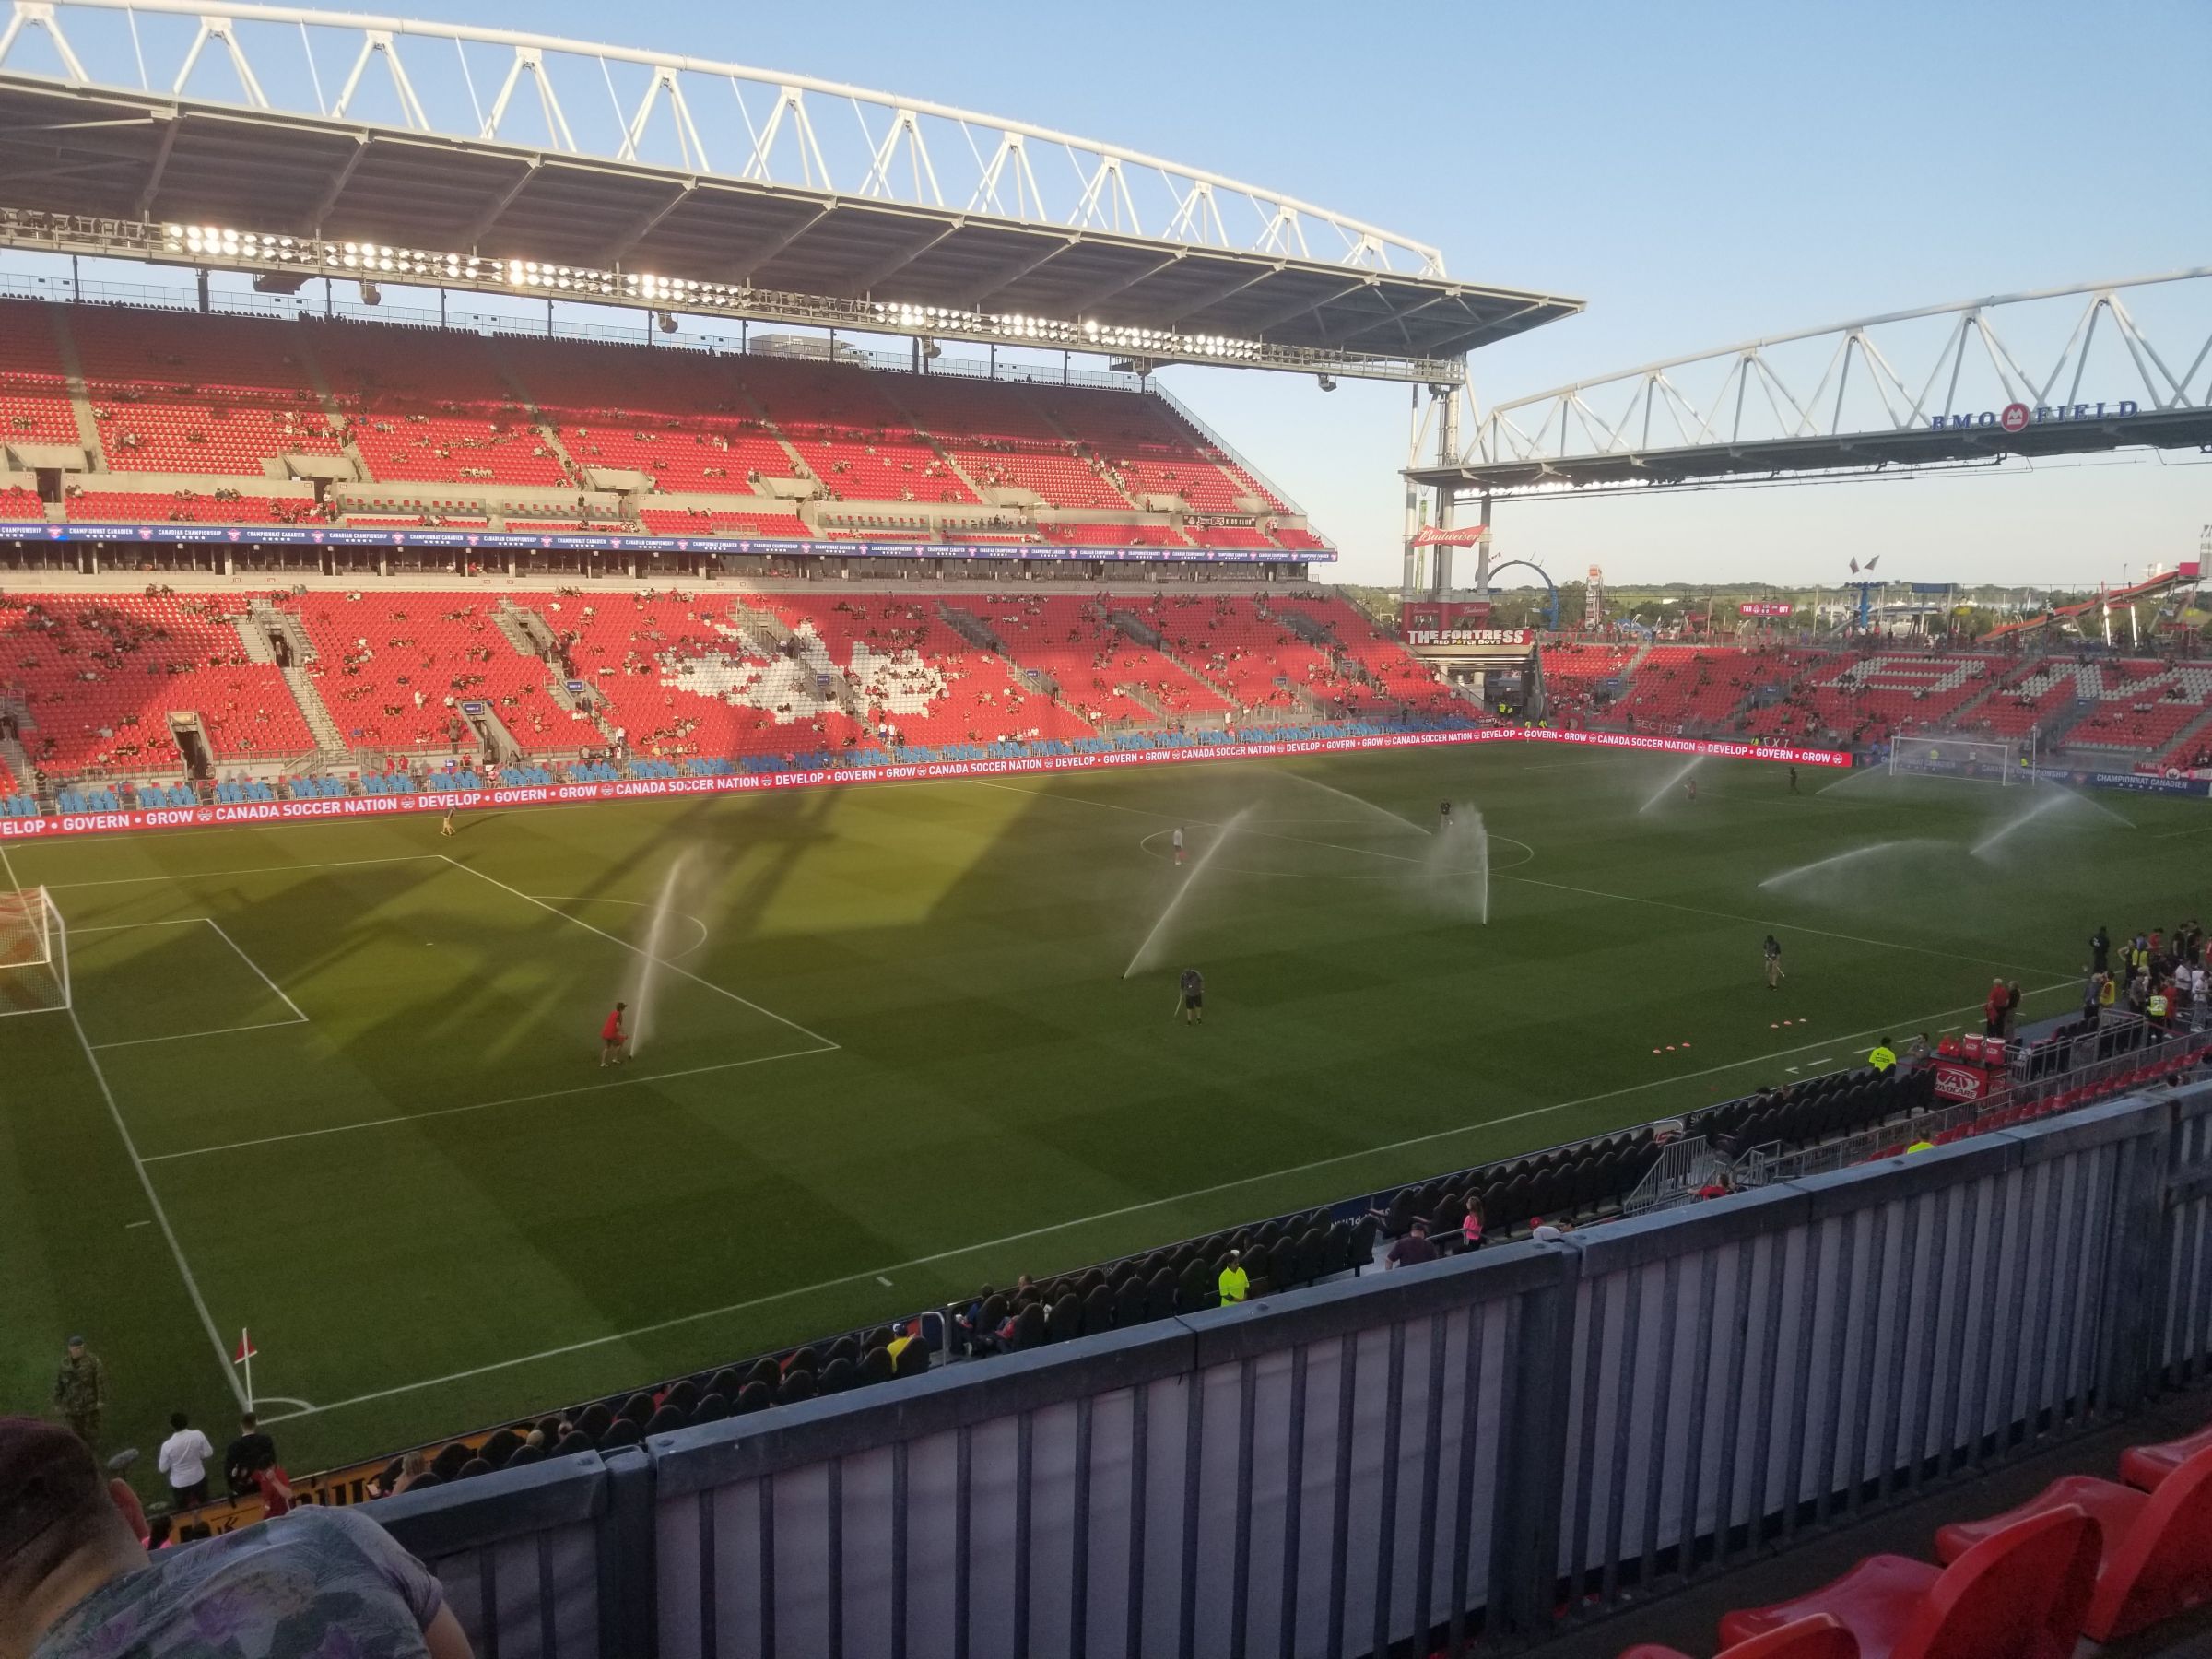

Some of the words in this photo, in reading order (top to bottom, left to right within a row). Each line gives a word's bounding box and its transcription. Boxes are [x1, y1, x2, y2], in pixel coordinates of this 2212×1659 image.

[1931, 411, 1996, 431] BMO
[2036, 400, 2139, 425] FIELD
[1418, 529, 1479, 543] Budweiser
[1407, 630, 1439, 644] THE
[1441, 629, 1524, 644] FORTRESS
[1392, 735, 1419, 745] CANADA
[1421, 733, 1446, 743] SOCCER
[1449, 732, 1471, 741] NATION
[1481, 729, 1515, 738] DEVELOP
[1524, 729, 1557, 739] GOVERN
[1564, 732, 1586, 741] GROW
[1598, 735, 1630, 745] CANADA
[1631, 736, 1663, 747] SOCCER
[1665, 739, 1695, 750] NATION
[1182, 747, 1214, 759] CANADA
[1248, 744, 1275, 754] NATION
[1287, 741, 1320, 752] DEVELOP
[1326, 739, 1355, 749] GOVERN
[1362, 737, 1382, 747] GROW
[1708, 743, 1747, 755] DEVELOP
[1757, 747, 1793, 759] GOVERN
[1802, 751, 1830, 762] GROW
[1055, 755, 1095, 767] DEVELOP
[1103, 752, 1136, 763] GOVERN
[1146, 750, 1170, 760] GROW
[929, 763, 968, 775] CANADA
[971, 760, 1006, 772] SOCCER
[1009, 759, 1041, 770] NATION
[775, 771, 824, 785] DEVELOP
[834, 768, 876, 782] GOVERN
[887, 766, 915, 778] GROW
[2097, 773, 2149, 785] CHAMPIONNAT
[2150, 778, 2188, 790] CANADIEN
[617, 782, 665, 794] CANADA
[669, 778, 714, 792] SOCCER
[718, 776, 759, 789] NATION
[419, 793, 480, 807] DEVELOP
[494, 788, 546, 802] GOVERN
[559, 785, 597, 798] GROW
[216, 805, 279, 820] CANADA
[283, 800, 341, 816] SOCCER
[345, 797, 396, 812] NATION
[63, 813, 129, 830] GOVERN
[147, 809, 193, 825] GROW
[1934, 1083, 1977, 1099] DVOCARE
